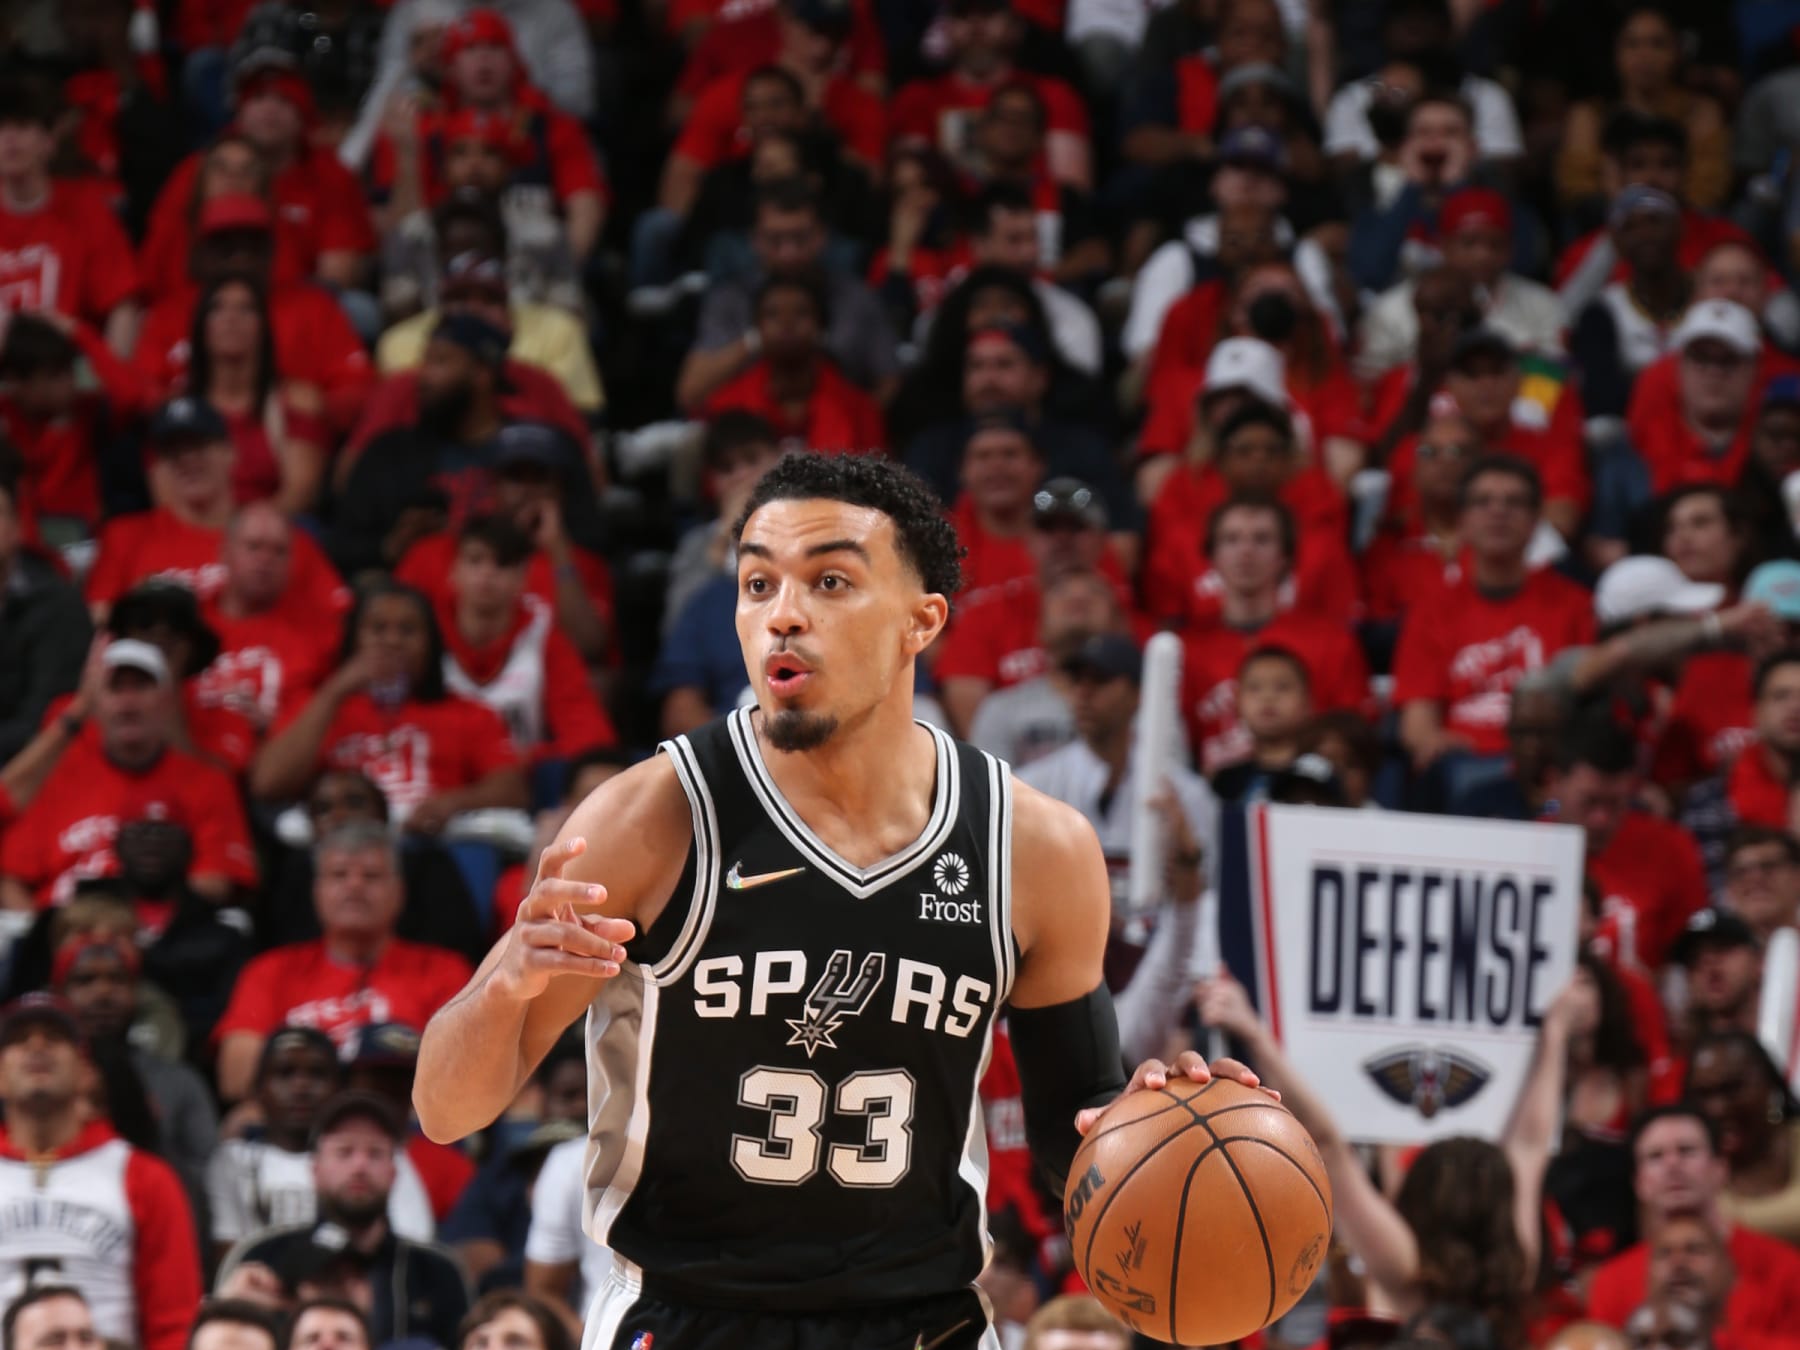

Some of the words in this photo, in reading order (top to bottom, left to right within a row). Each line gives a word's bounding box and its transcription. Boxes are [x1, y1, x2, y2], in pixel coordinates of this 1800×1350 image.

[918, 893, 982, 924] Frost
[1309, 866, 1555, 1029] DEFENSE
[693, 949, 991, 1058] SPURS
[729, 1065, 917, 1189] 33
